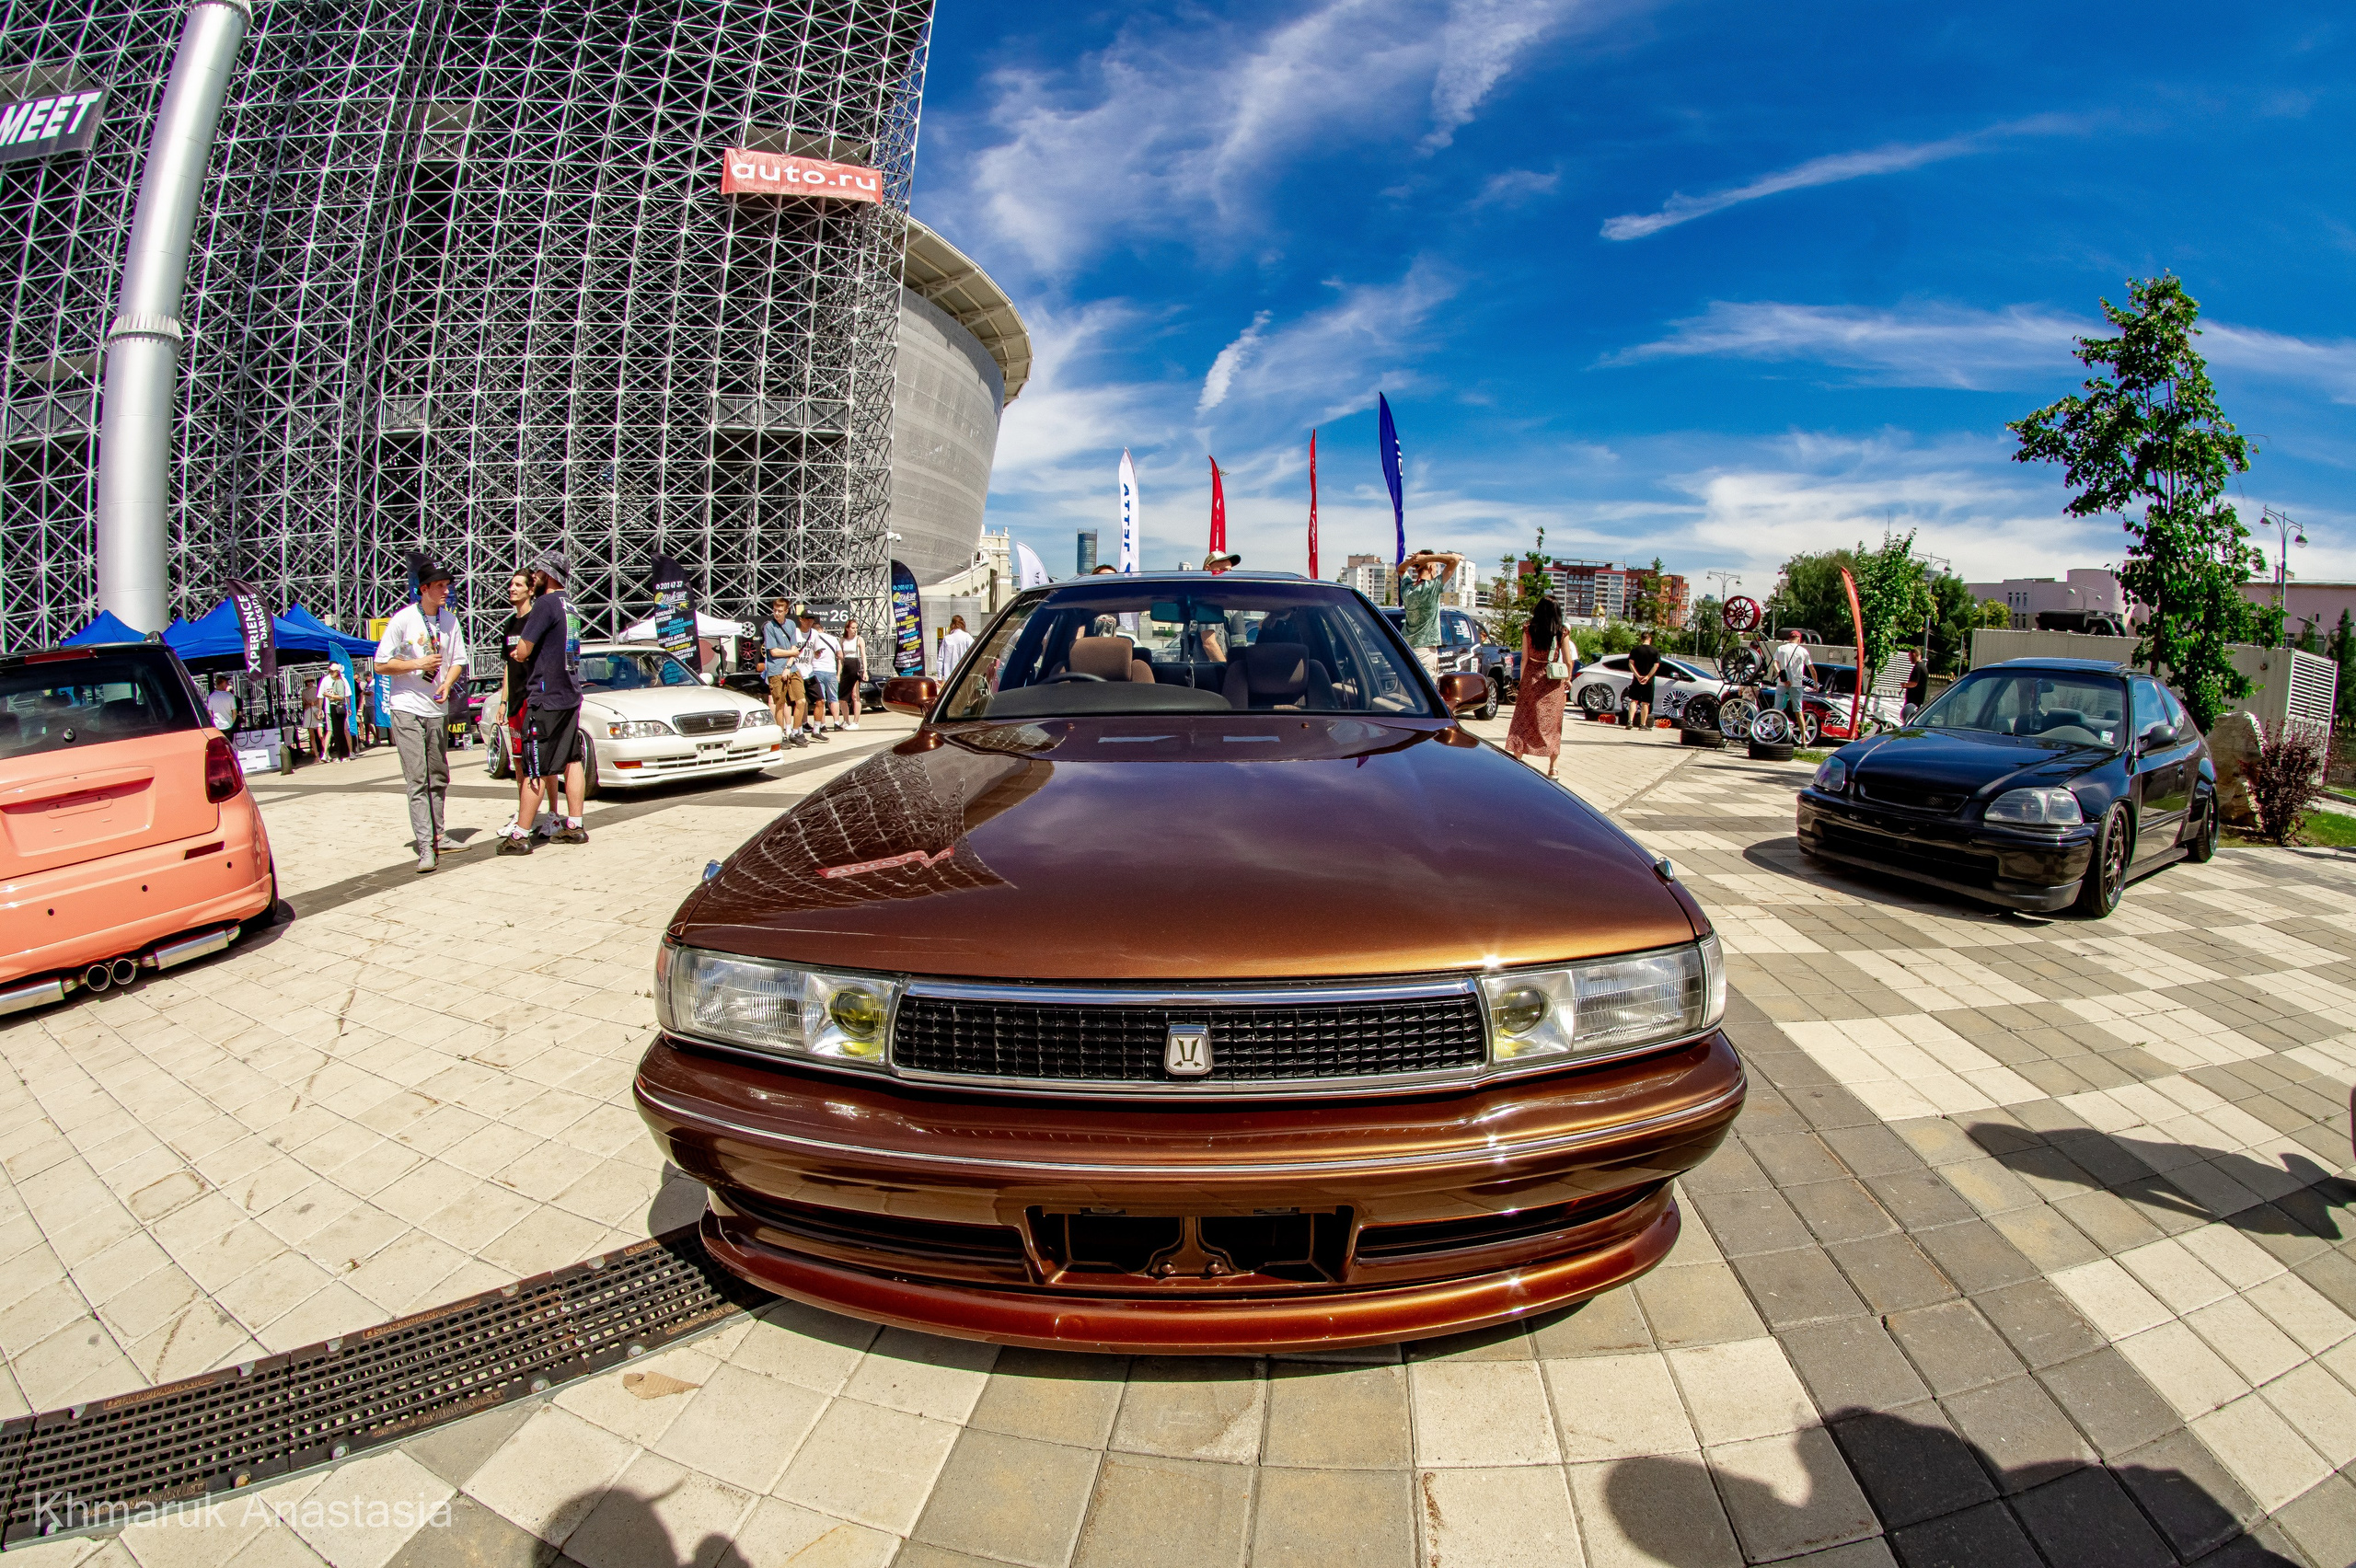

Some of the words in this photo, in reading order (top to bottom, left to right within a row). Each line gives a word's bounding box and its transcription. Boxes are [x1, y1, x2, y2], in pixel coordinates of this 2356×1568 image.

[0, 90, 103, 147] MEET
[731, 162, 877, 191] auto.ru
[248, 593, 269, 640] DARKSIDE
[829, 609, 849, 622] 26
[237, 594, 262, 673] XPERIENCE
[379, 674, 390, 716] Starlin
[375, 1309, 441, 1335] STANDARTPARK
[114, 1384, 178, 1407] STANDARTPARK
